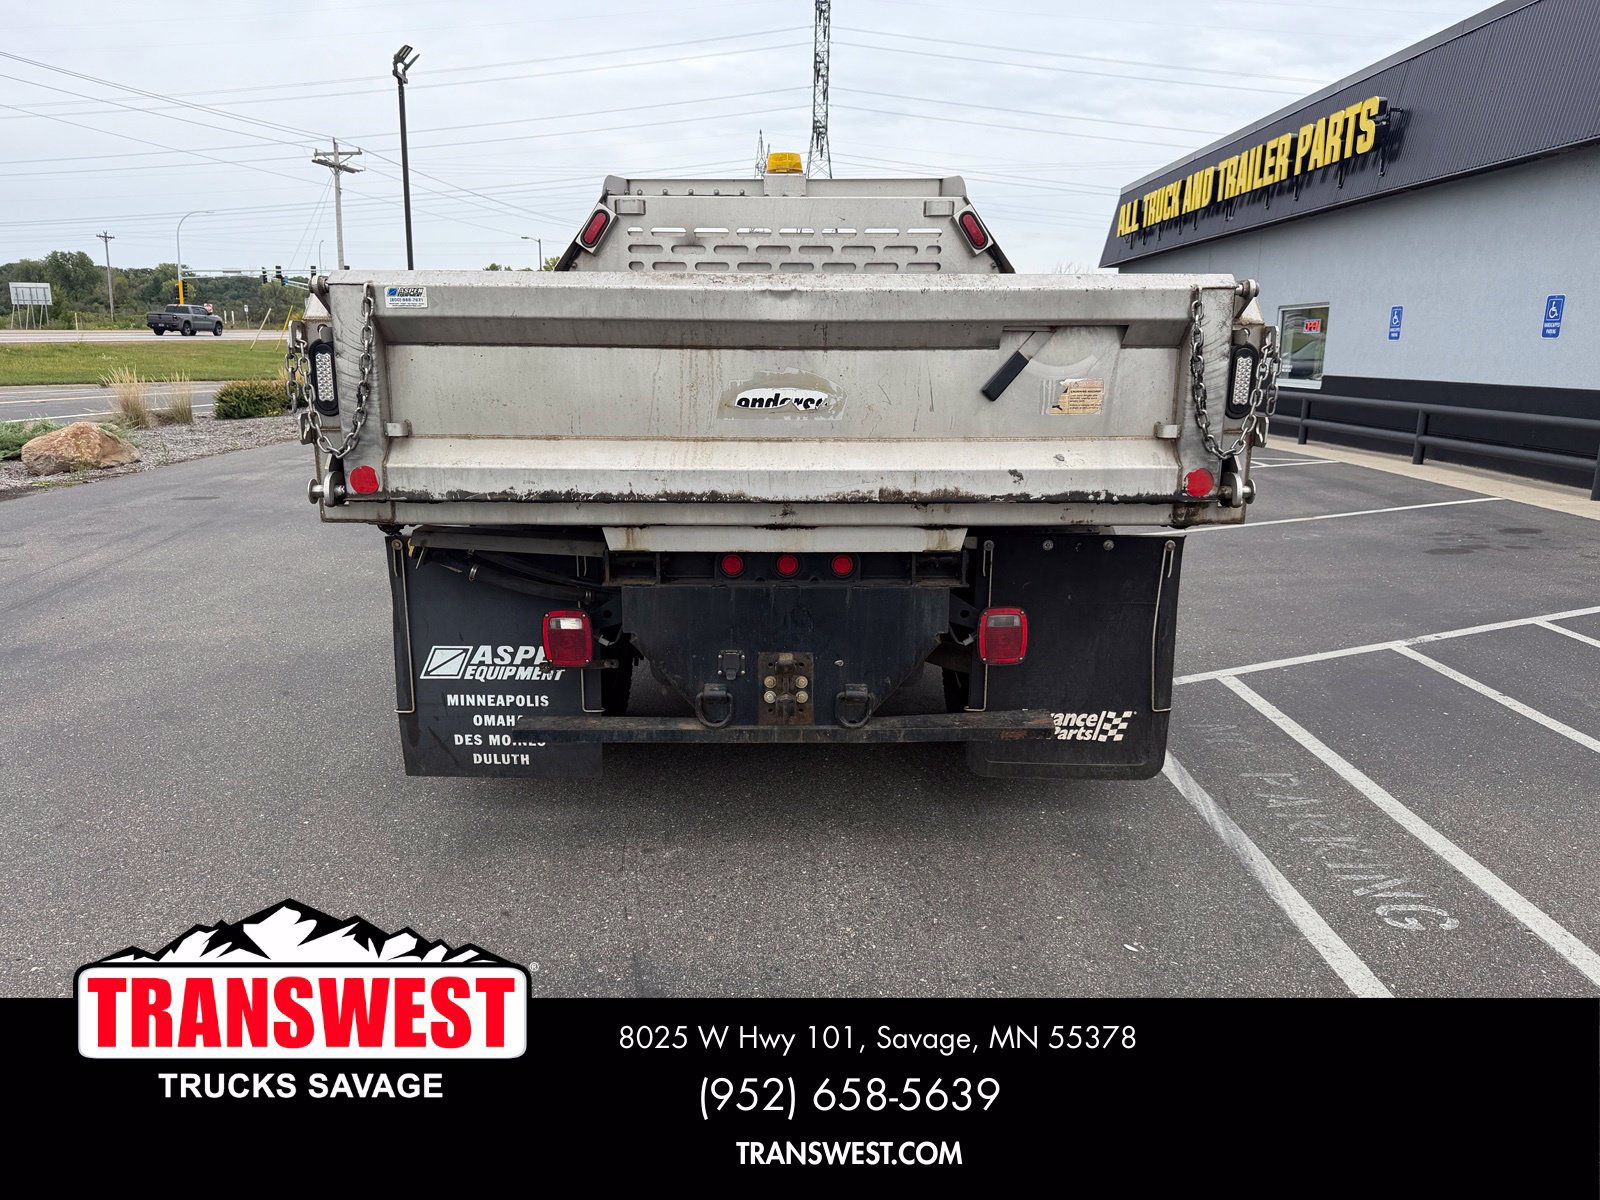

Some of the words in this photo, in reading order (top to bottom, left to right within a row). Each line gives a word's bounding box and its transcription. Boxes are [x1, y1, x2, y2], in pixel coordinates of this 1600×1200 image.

[1117, 199, 1139, 237] ALL
[1142, 179, 1182, 228] TRUCK
[1182, 167, 1215, 214] AND
[1217, 133, 1292, 201] TRAILER
[1294, 96, 1380, 176] PARTS
[446, 694, 550, 707] MINNEAPOLIS
[473, 714, 524, 727] OMAH
[454, 734, 483, 746] DES
[473, 753, 530, 766] DULUTH
